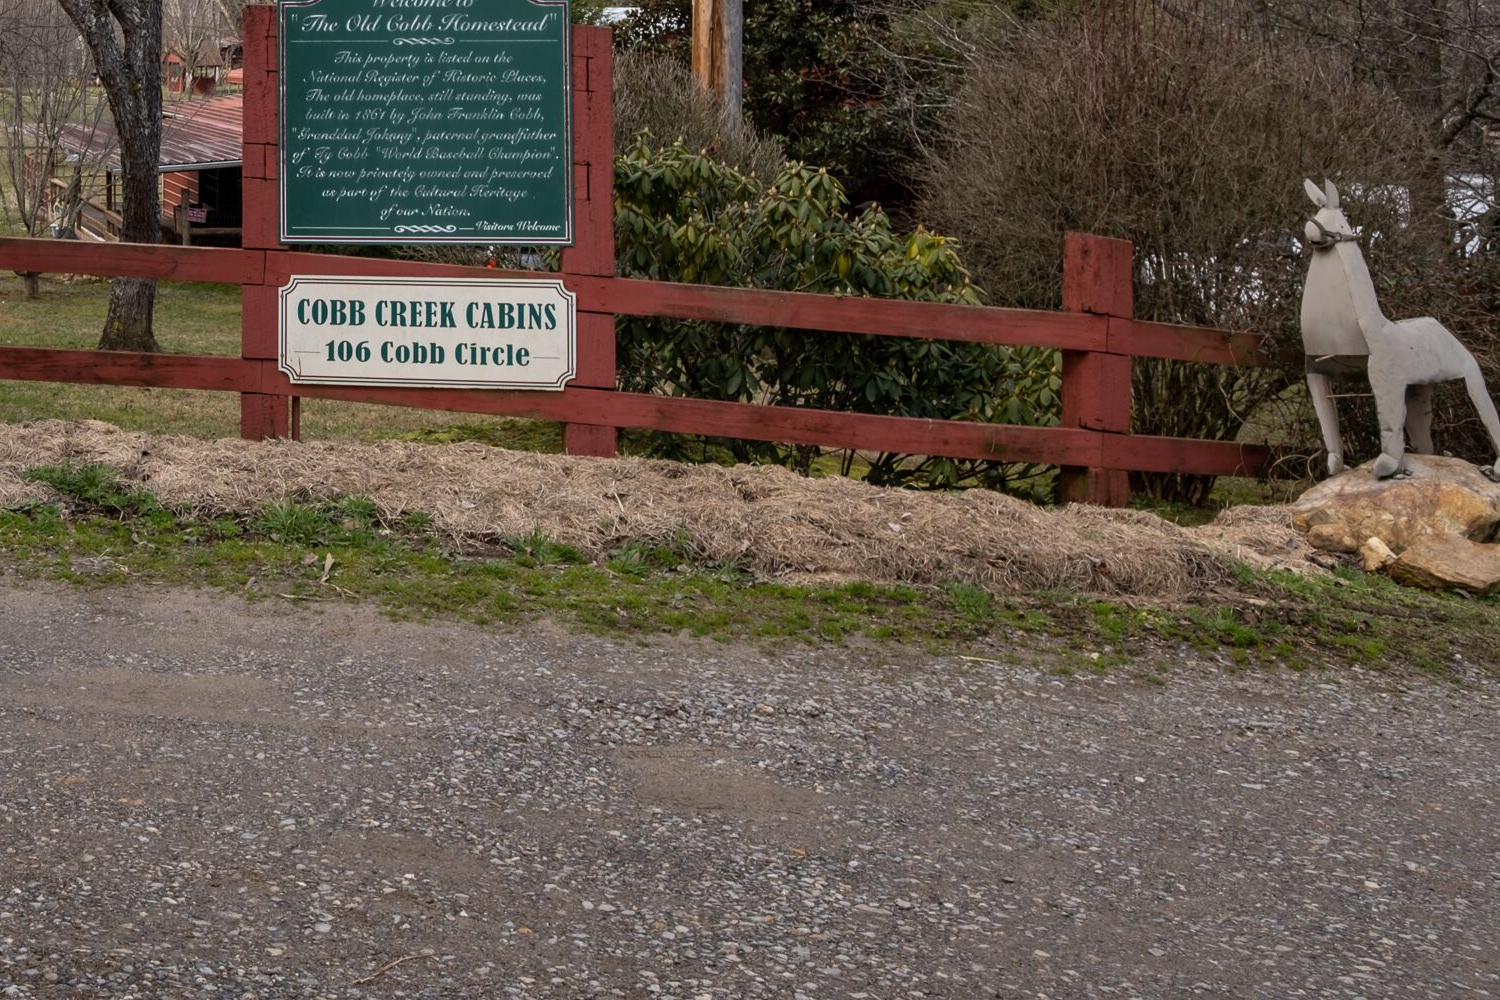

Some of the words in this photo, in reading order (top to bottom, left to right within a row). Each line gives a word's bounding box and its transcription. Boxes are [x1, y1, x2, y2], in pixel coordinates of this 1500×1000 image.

[291, 13, 339, 32] "The
[346, 14, 382, 32] Old
[386, 14, 433, 32] Cobb
[438, 13, 558, 32] Homestead"
[334, 51, 362, 63] This
[363, 53, 420, 68] property
[424, 52, 433, 63] is
[438, 51, 473, 63] listed
[494, 51, 514, 63] the
[303, 70, 362, 82] National
[364, 70, 420, 87] Register
[422, 70, 440, 87] of
[443, 70, 497, 82] Historic
[501, 70, 546, 84] Places,
[306, 89, 331, 101] The
[333, 89, 356, 101] old
[356, 89, 424, 106] homeplace,
[428, 89, 454, 101] still
[455, 89, 512, 106] standing,
[306, 108, 335, 120] built
[338, 110, 350, 120] in
[355, 108, 386, 120] 1861
[390, 108, 405, 124] by
[407, 107, 443, 124] John
[447, 107, 504, 120] Franklin
[510, 107, 544, 123] Cobb,
[422, 128, 480, 144] paternal
[477, 128, 556, 144] grandfather
[292, 146, 310, 164] of
[314, 146, 332, 164] Ty
[338, 146, 368, 160] Cobb
[425, 146, 485, 160] Baseball
[296, 165, 314, 178] It
[315, 167, 326, 178] is
[357, 166, 416, 182] privately
[419, 166, 462, 178] owned
[464, 166, 489, 178] and
[488, 166, 554, 183] preserved
[336, 187, 368, 201] part
[370, 185, 387, 201] of
[390, 185, 410, 197] the
[414, 185, 468, 197] Cultural
[470, 184, 528, 201] Heritage
[380, 204, 398, 220] of
[422, 204, 470, 216] Nation.
[476, 220, 514, 231] Visitors
[516, 220, 561, 231] Welcome
[297, 298, 366, 326] COBB
[375, 300, 457, 328] CREEK
[466, 302, 557, 330] CABINS
[325, 340, 371, 362] 106
[380, 341, 446, 365] Cobb
[454, 342, 530, 366] Circle
